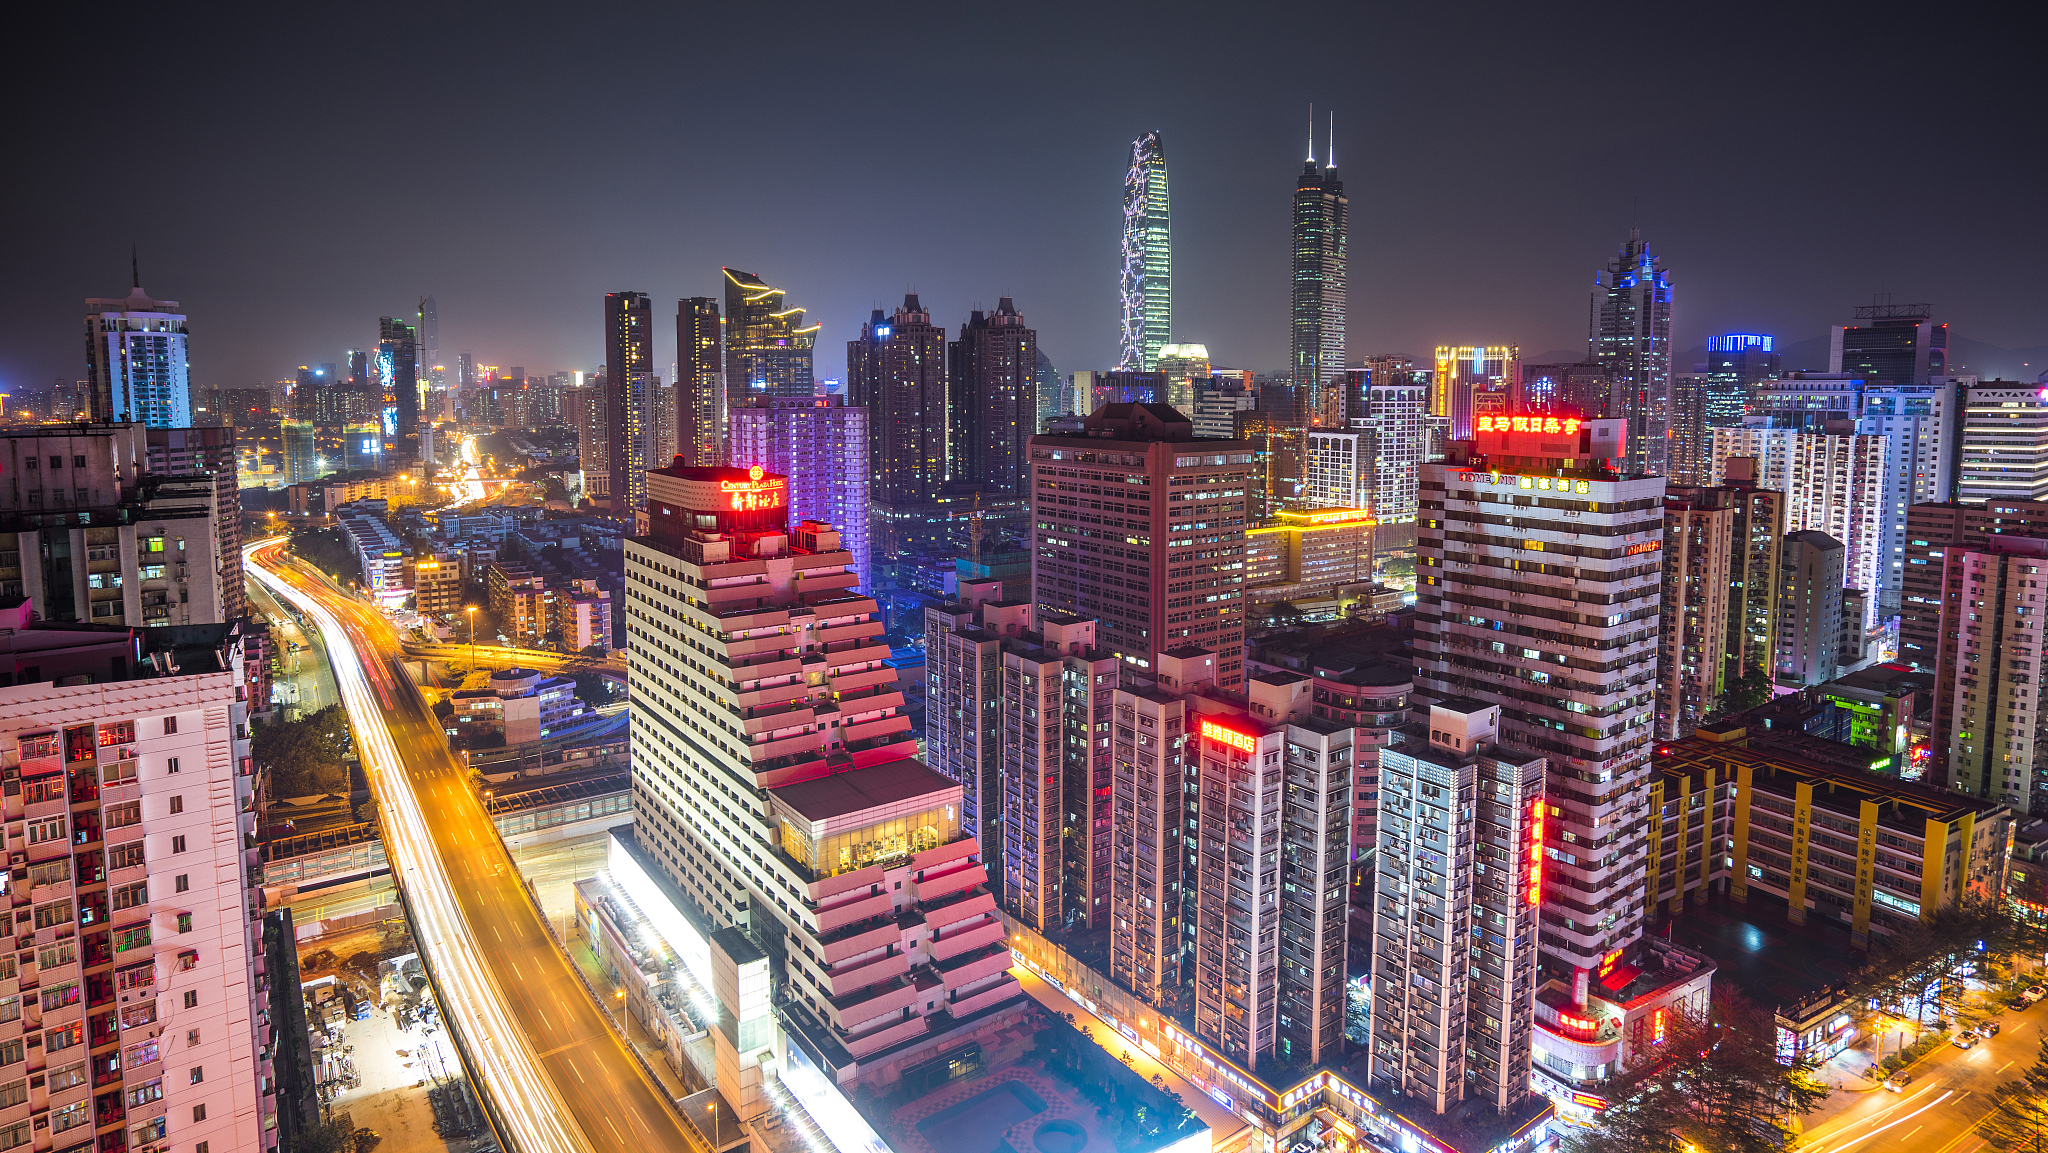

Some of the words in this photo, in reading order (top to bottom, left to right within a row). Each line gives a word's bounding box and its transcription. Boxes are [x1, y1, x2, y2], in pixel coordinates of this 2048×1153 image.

[1477, 416, 1581, 435] 皇马假日桑拿
[721, 480, 752, 489] CENTURY
[752, 480, 769, 488] PLAZA
[1459, 473, 1490, 484] HOME
[731, 491, 780, 511] 新都酒店
